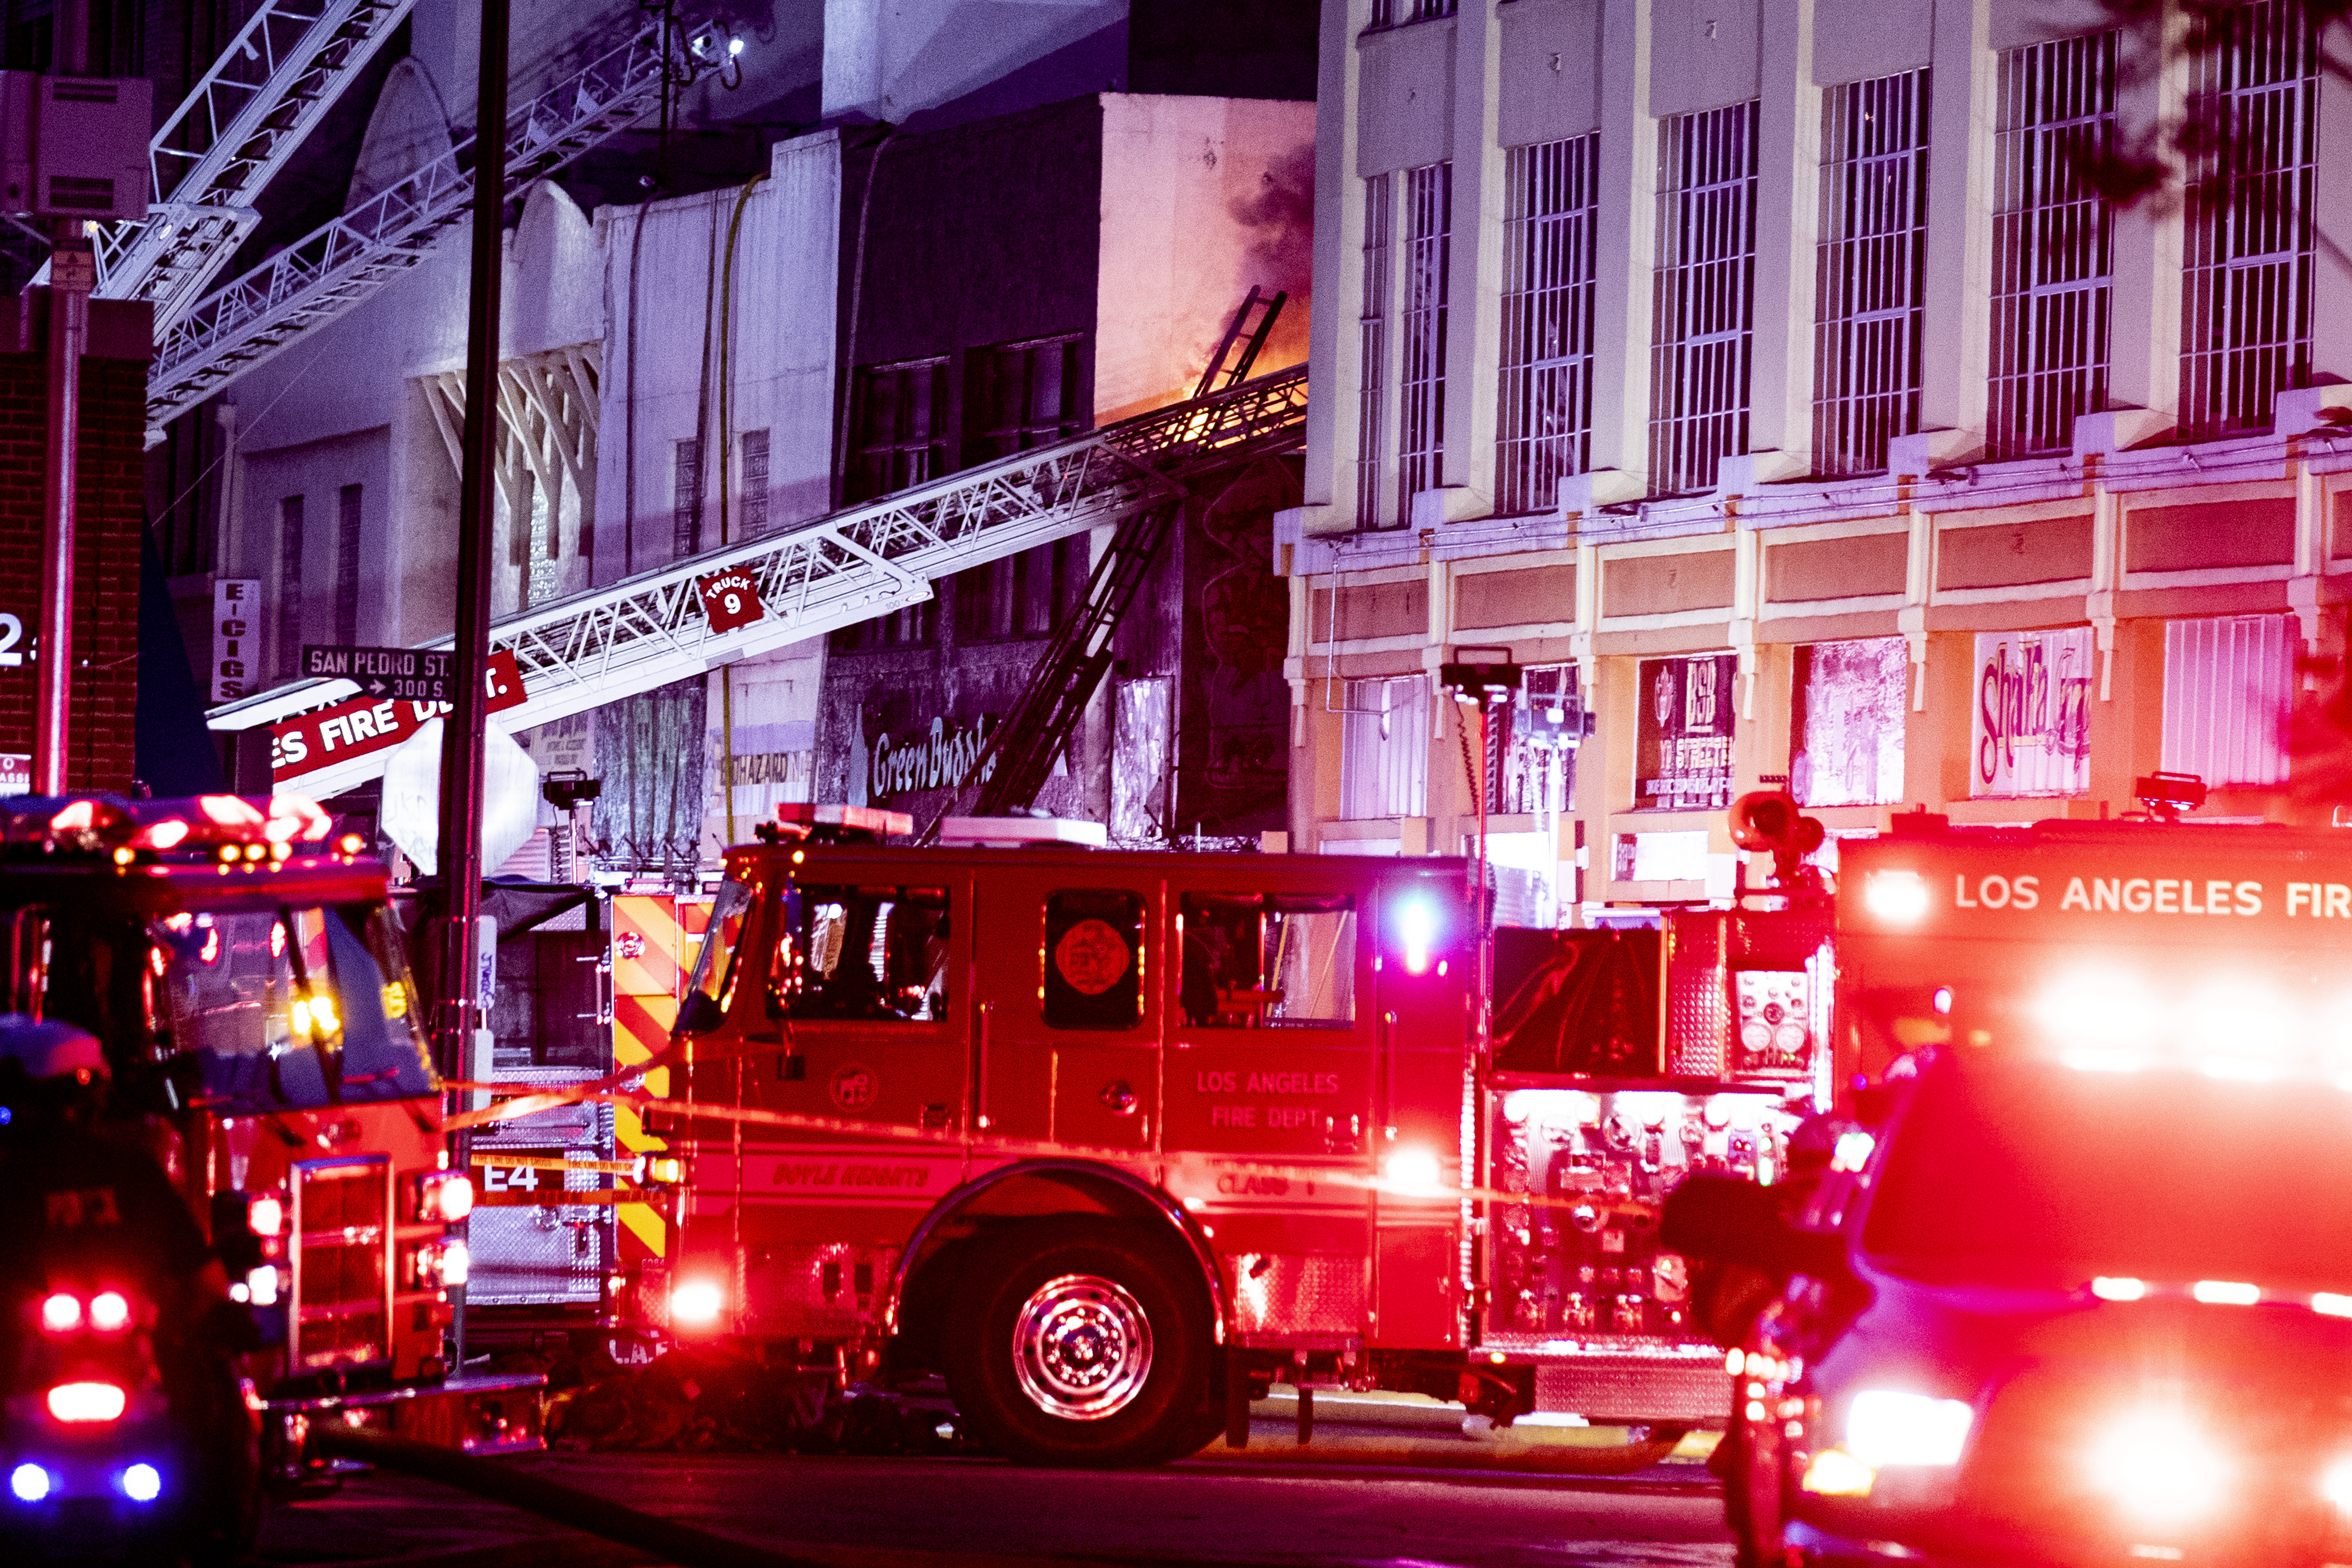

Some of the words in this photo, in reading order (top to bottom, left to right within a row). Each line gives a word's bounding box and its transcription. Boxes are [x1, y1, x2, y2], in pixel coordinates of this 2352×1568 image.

[706, 576, 751, 598] TRUCK
[724, 593, 741, 614] 9
[310, 650, 347, 673] SAN
[354, 651, 415, 676] PEDRO
[393, 679, 427, 697] 300
[319, 698, 399, 752] FIRE
[874, 732, 927, 796] Green
[1955, 874, 2039, 910] LOS
[2060, 876, 2263, 916] ANGELES
[1197, 1071, 1236, 1092] LOS
[1247, 1072, 1339, 1094] ANGELES
[1212, 1106, 1256, 1127] FIRE
[484, 1164, 539, 1192] E4
[772, 1163, 839, 1186] BOYLE
[1217, 1175, 1290, 1196] CLASS
